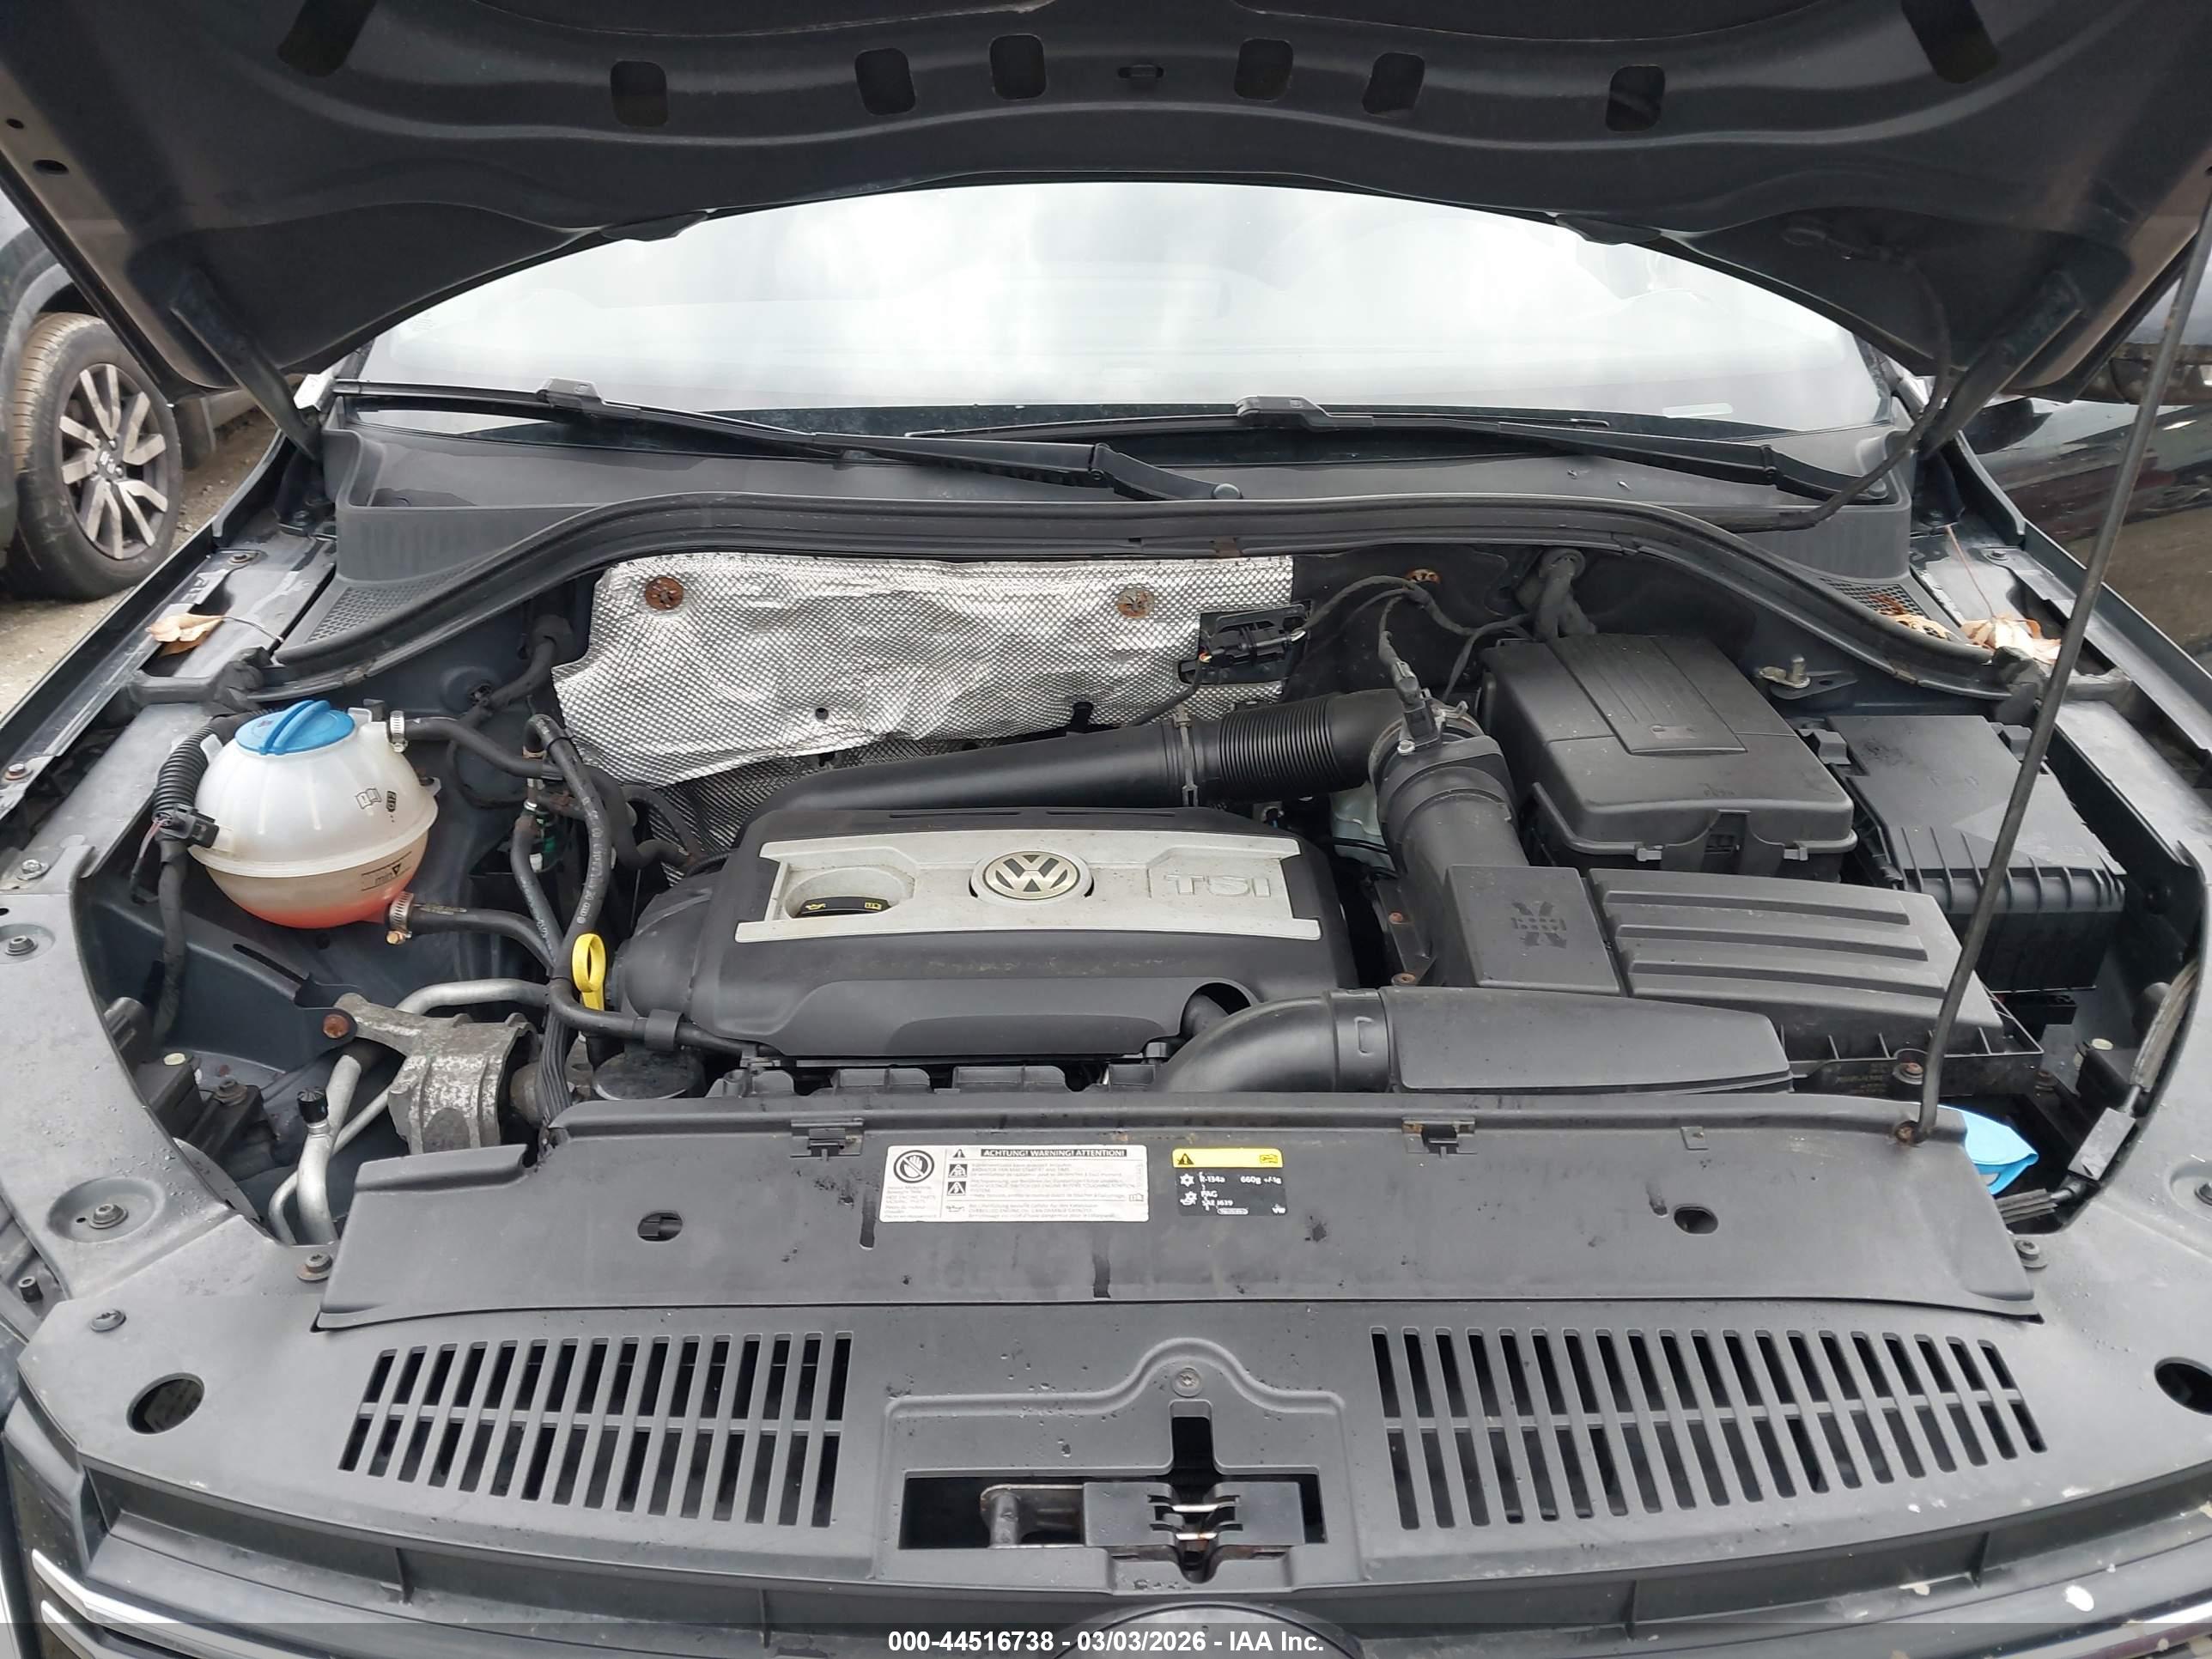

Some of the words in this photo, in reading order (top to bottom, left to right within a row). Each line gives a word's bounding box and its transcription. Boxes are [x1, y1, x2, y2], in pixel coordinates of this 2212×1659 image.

[1165, 873, 1271, 897] TSI
[983, 1149, 1029, 1158] ACHTUNG!
[1030, 1149, 1075, 1158] WARNING!
[1076, 1149, 1126, 1158] ATTENTION!
